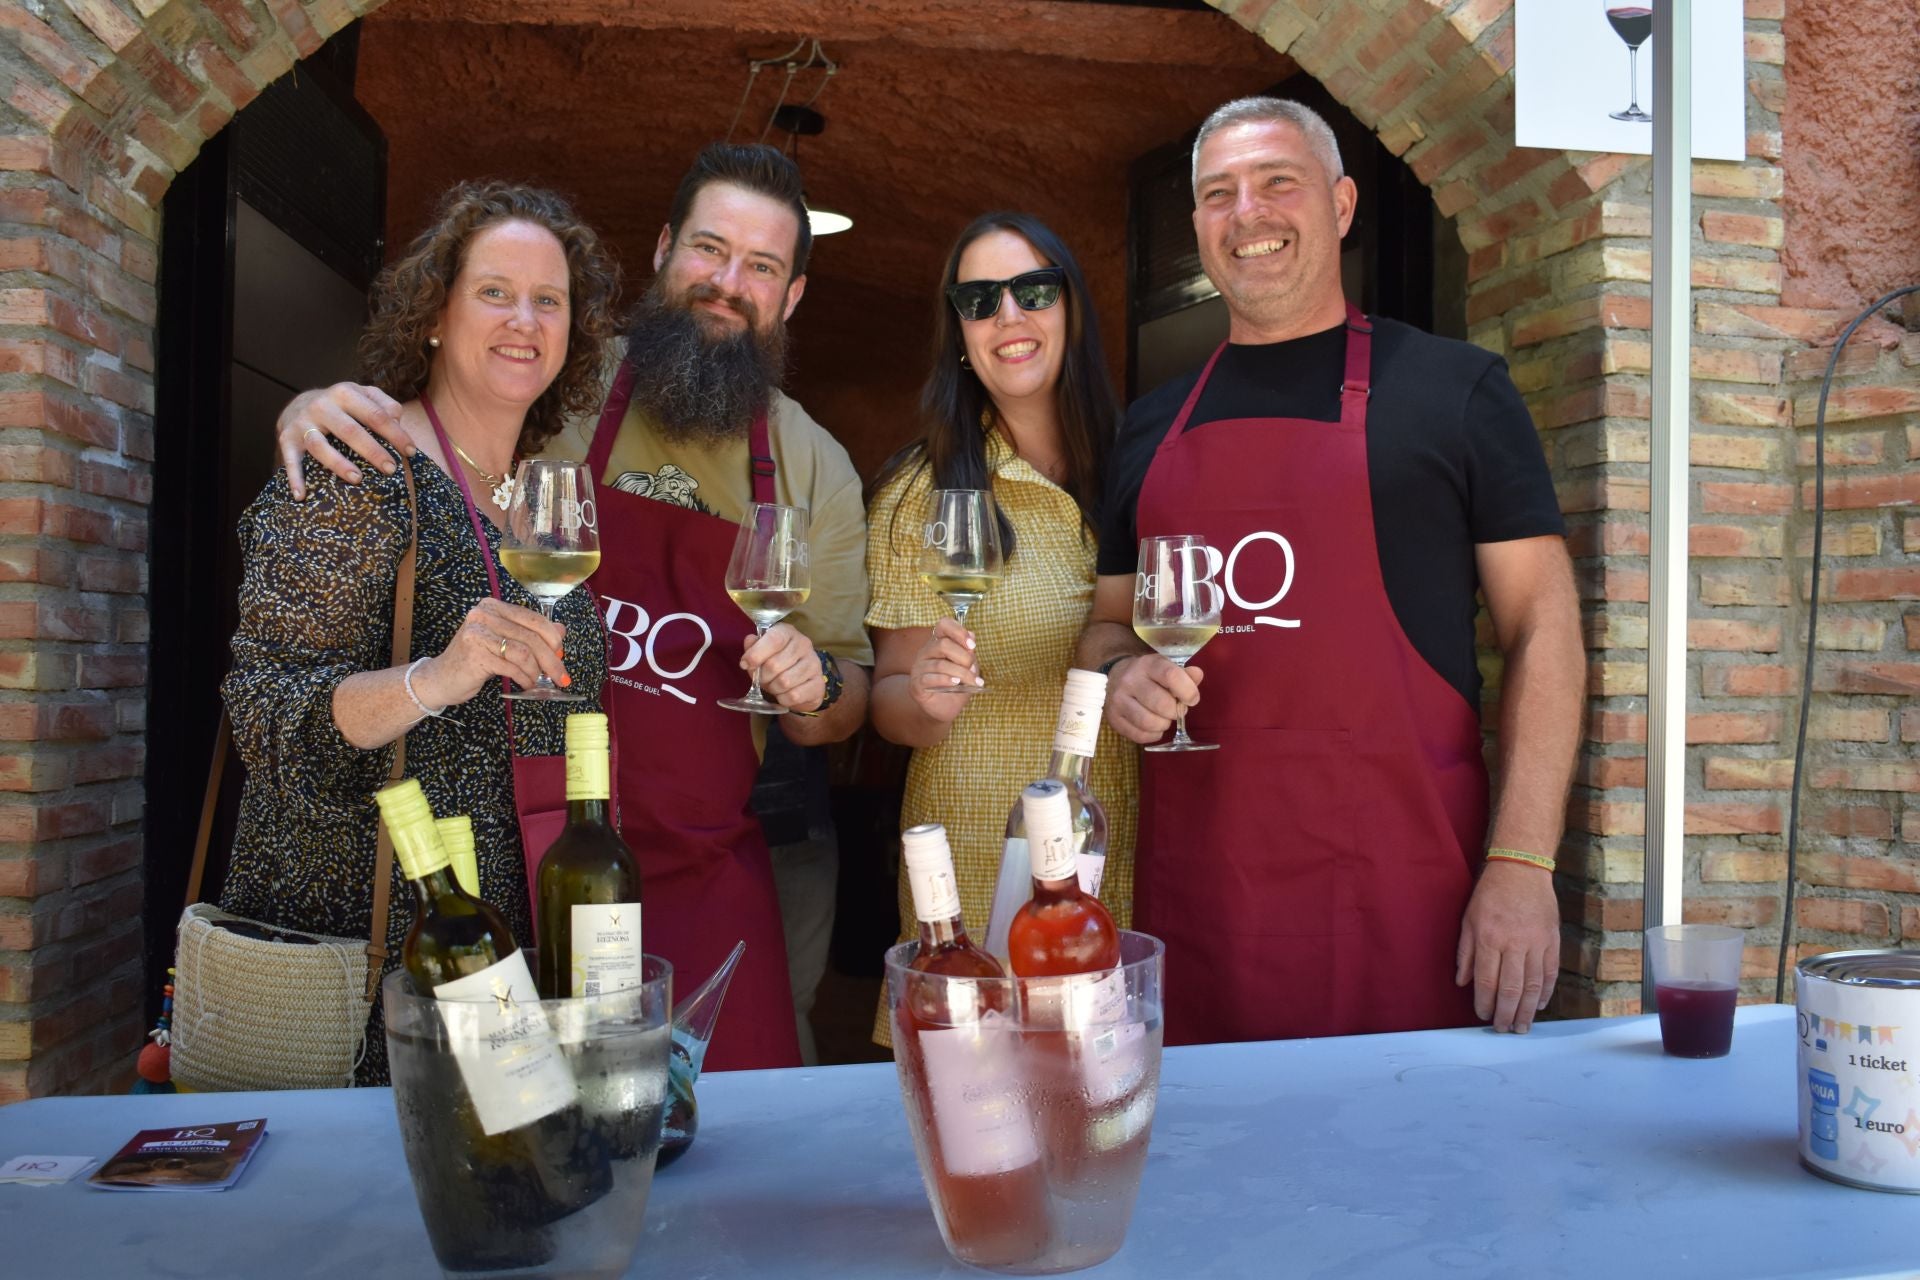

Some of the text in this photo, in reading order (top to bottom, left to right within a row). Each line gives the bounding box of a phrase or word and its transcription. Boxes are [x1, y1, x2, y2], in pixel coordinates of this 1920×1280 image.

[559, 498, 598, 535] BQ
[922, 521, 948, 551] BQ
[1173, 531, 1301, 628] BQ
[1225, 626, 1235, 634] DE
[1236, 625, 1256, 633] QUEL
[601, 595, 712, 705] BQ
[610, 674, 661, 696] DEGAS DE QUEL
[1799, 1012, 1811, 1047] Q
[1848, 1054, 1908, 1072] 1 ticket
[1855, 1117, 1905, 1134] 1 euro
